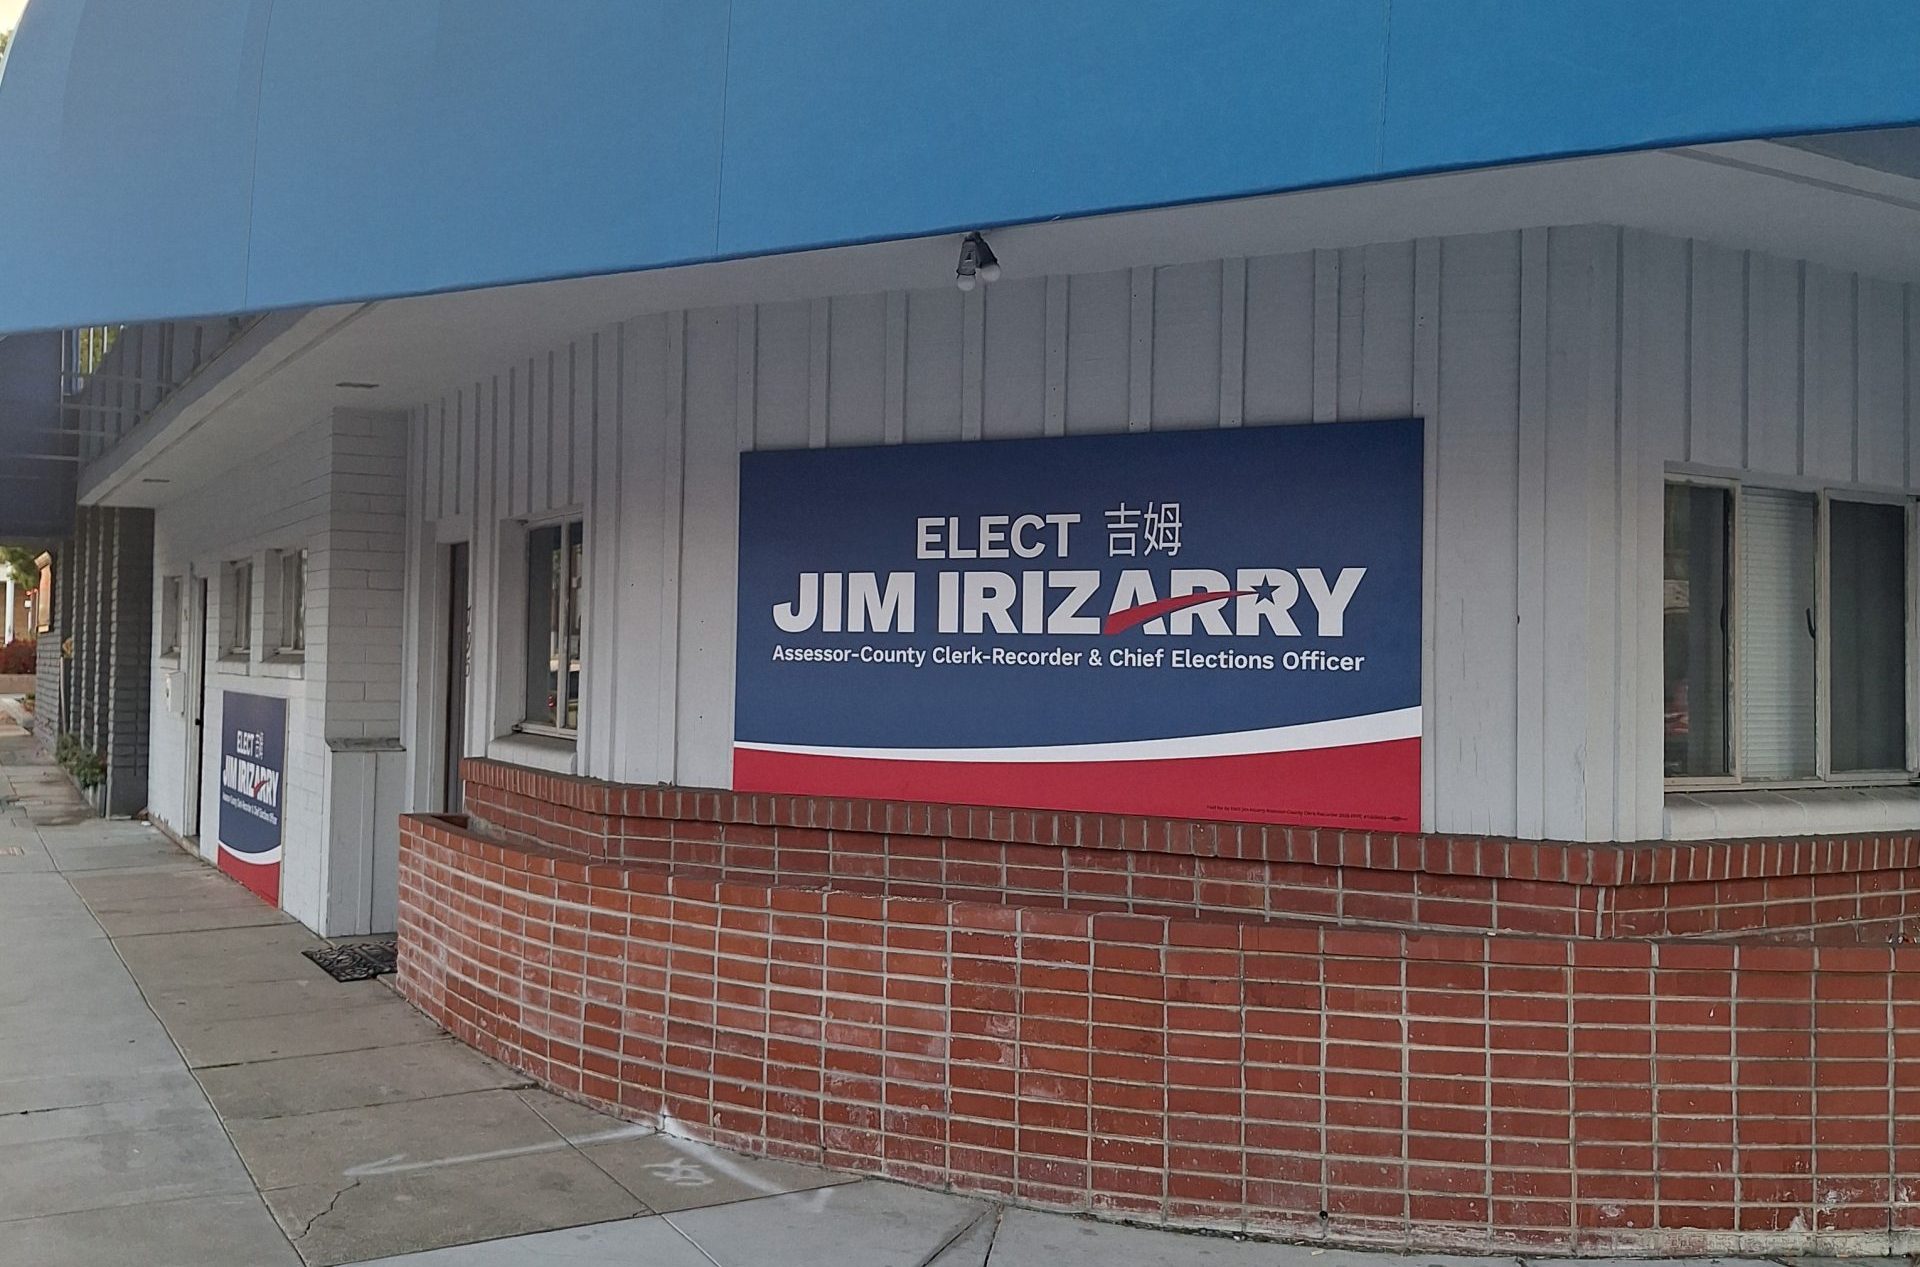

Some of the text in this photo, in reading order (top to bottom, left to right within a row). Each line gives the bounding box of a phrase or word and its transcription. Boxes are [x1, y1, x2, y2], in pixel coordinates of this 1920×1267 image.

[916, 513, 1081, 559] ELECT
[1104, 501, 1183, 557] 吉姆
[772, 567, 1368, 637] JIM IRIZARRY
[772, 644, 1365, 672] Assessor-County Clerk-Recorder & Chief Elections Officer
[237, 730, 255, 757] ELECT
[222, 754, 238, 790] JIM
